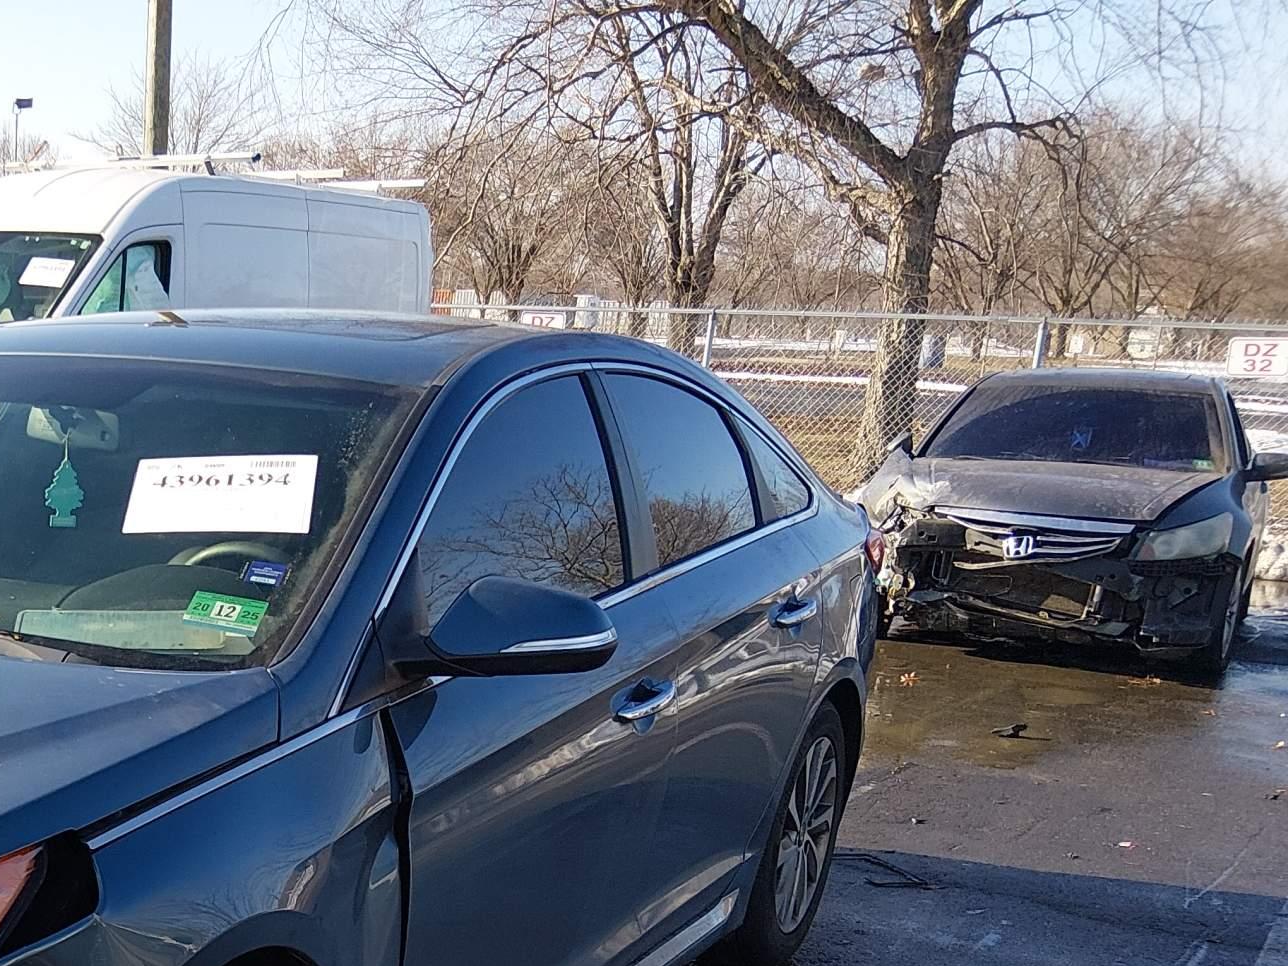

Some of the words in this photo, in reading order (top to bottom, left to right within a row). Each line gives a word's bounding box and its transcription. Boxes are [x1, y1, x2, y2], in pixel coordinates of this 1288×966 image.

[1244, 343, 1279, 357] DZ
[1243, 359, 1272, 372] 32
[152, 472, 291, 488] 43961394
[192, 602, 211, 612] 20
[214, 604, 237, 618] 12
[241, 610, 261, 620] 25
